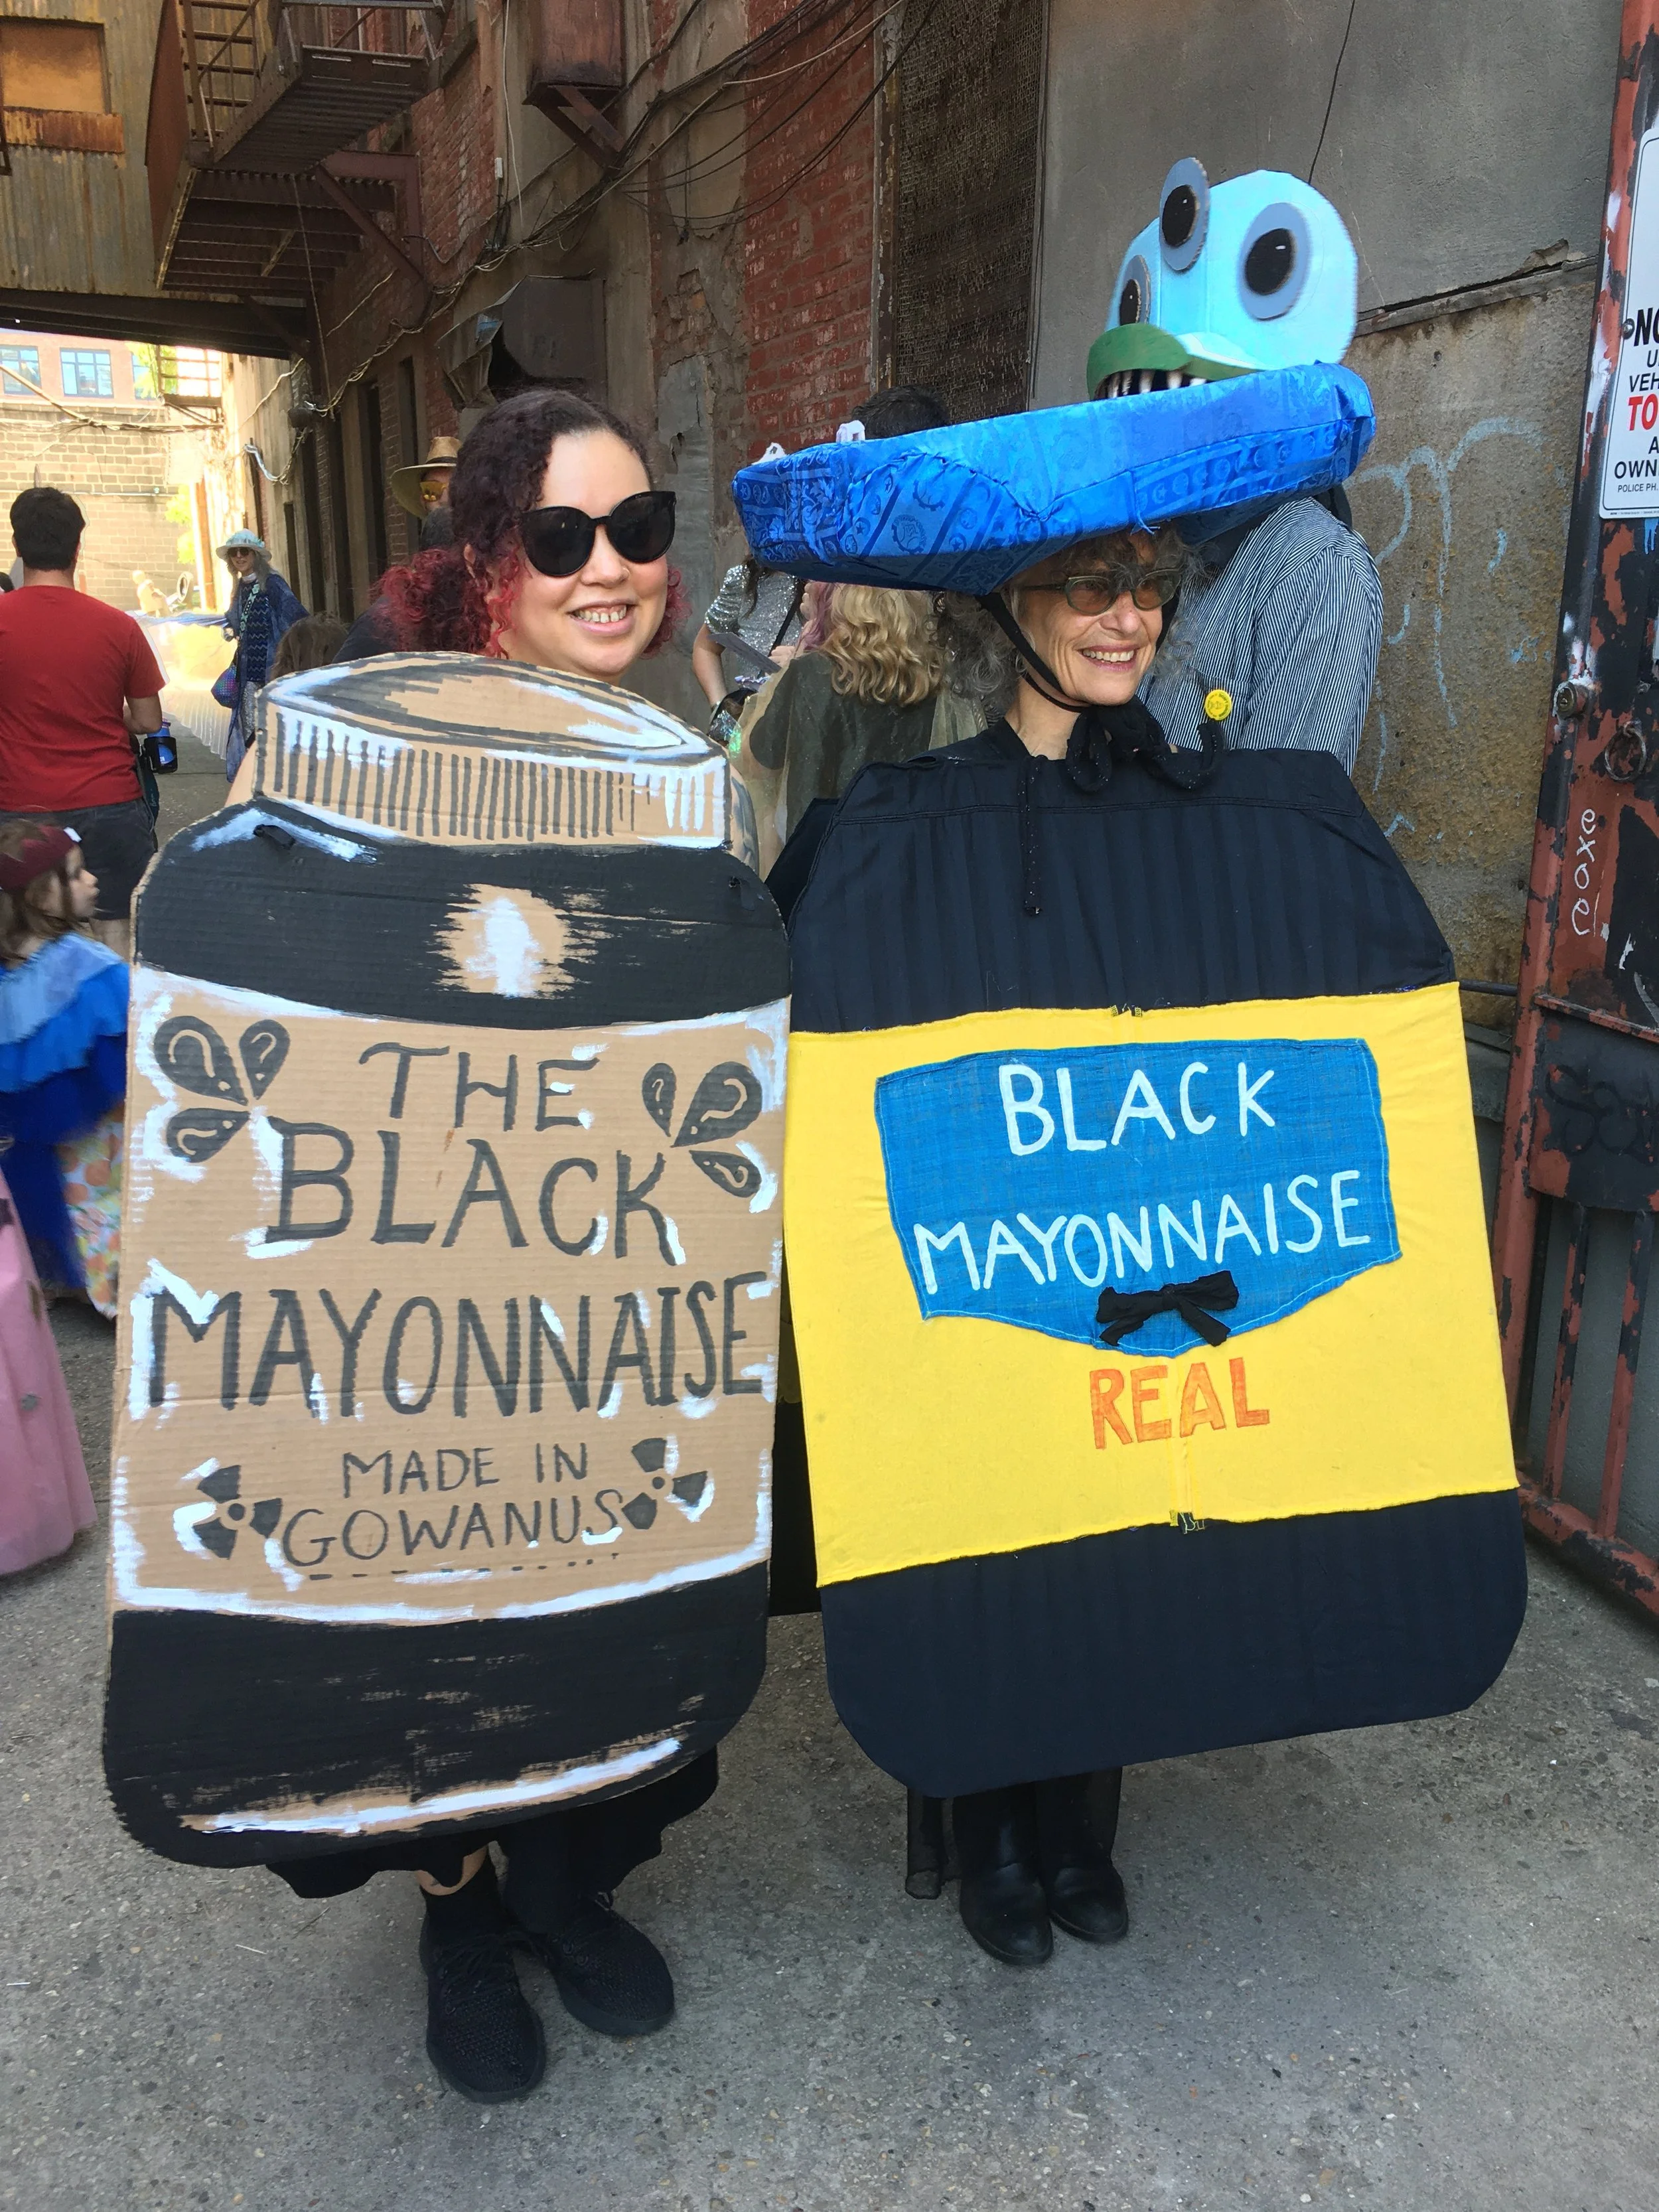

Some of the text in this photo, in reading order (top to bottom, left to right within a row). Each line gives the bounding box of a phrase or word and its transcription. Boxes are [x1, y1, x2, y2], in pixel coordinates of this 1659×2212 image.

[1646, 349, 1659, 368] U
[1617, 484, 1644, 492] POLICE
[359, 1042, 599, 1131] THE
[998, 1062, 1275, 1156] BLACK
[265, 1116, 680, 1266] BLACK
[913, 1169, 1370, 1295] MAYONNAISE
[148, 1270, 768, 1418] MAYONNAISE
[1089, 1357, 1270, 1451] REAL
[343, 1442, 587, 1498] MADE IN
[283, 1489, 624, 1567] GOWANUS
